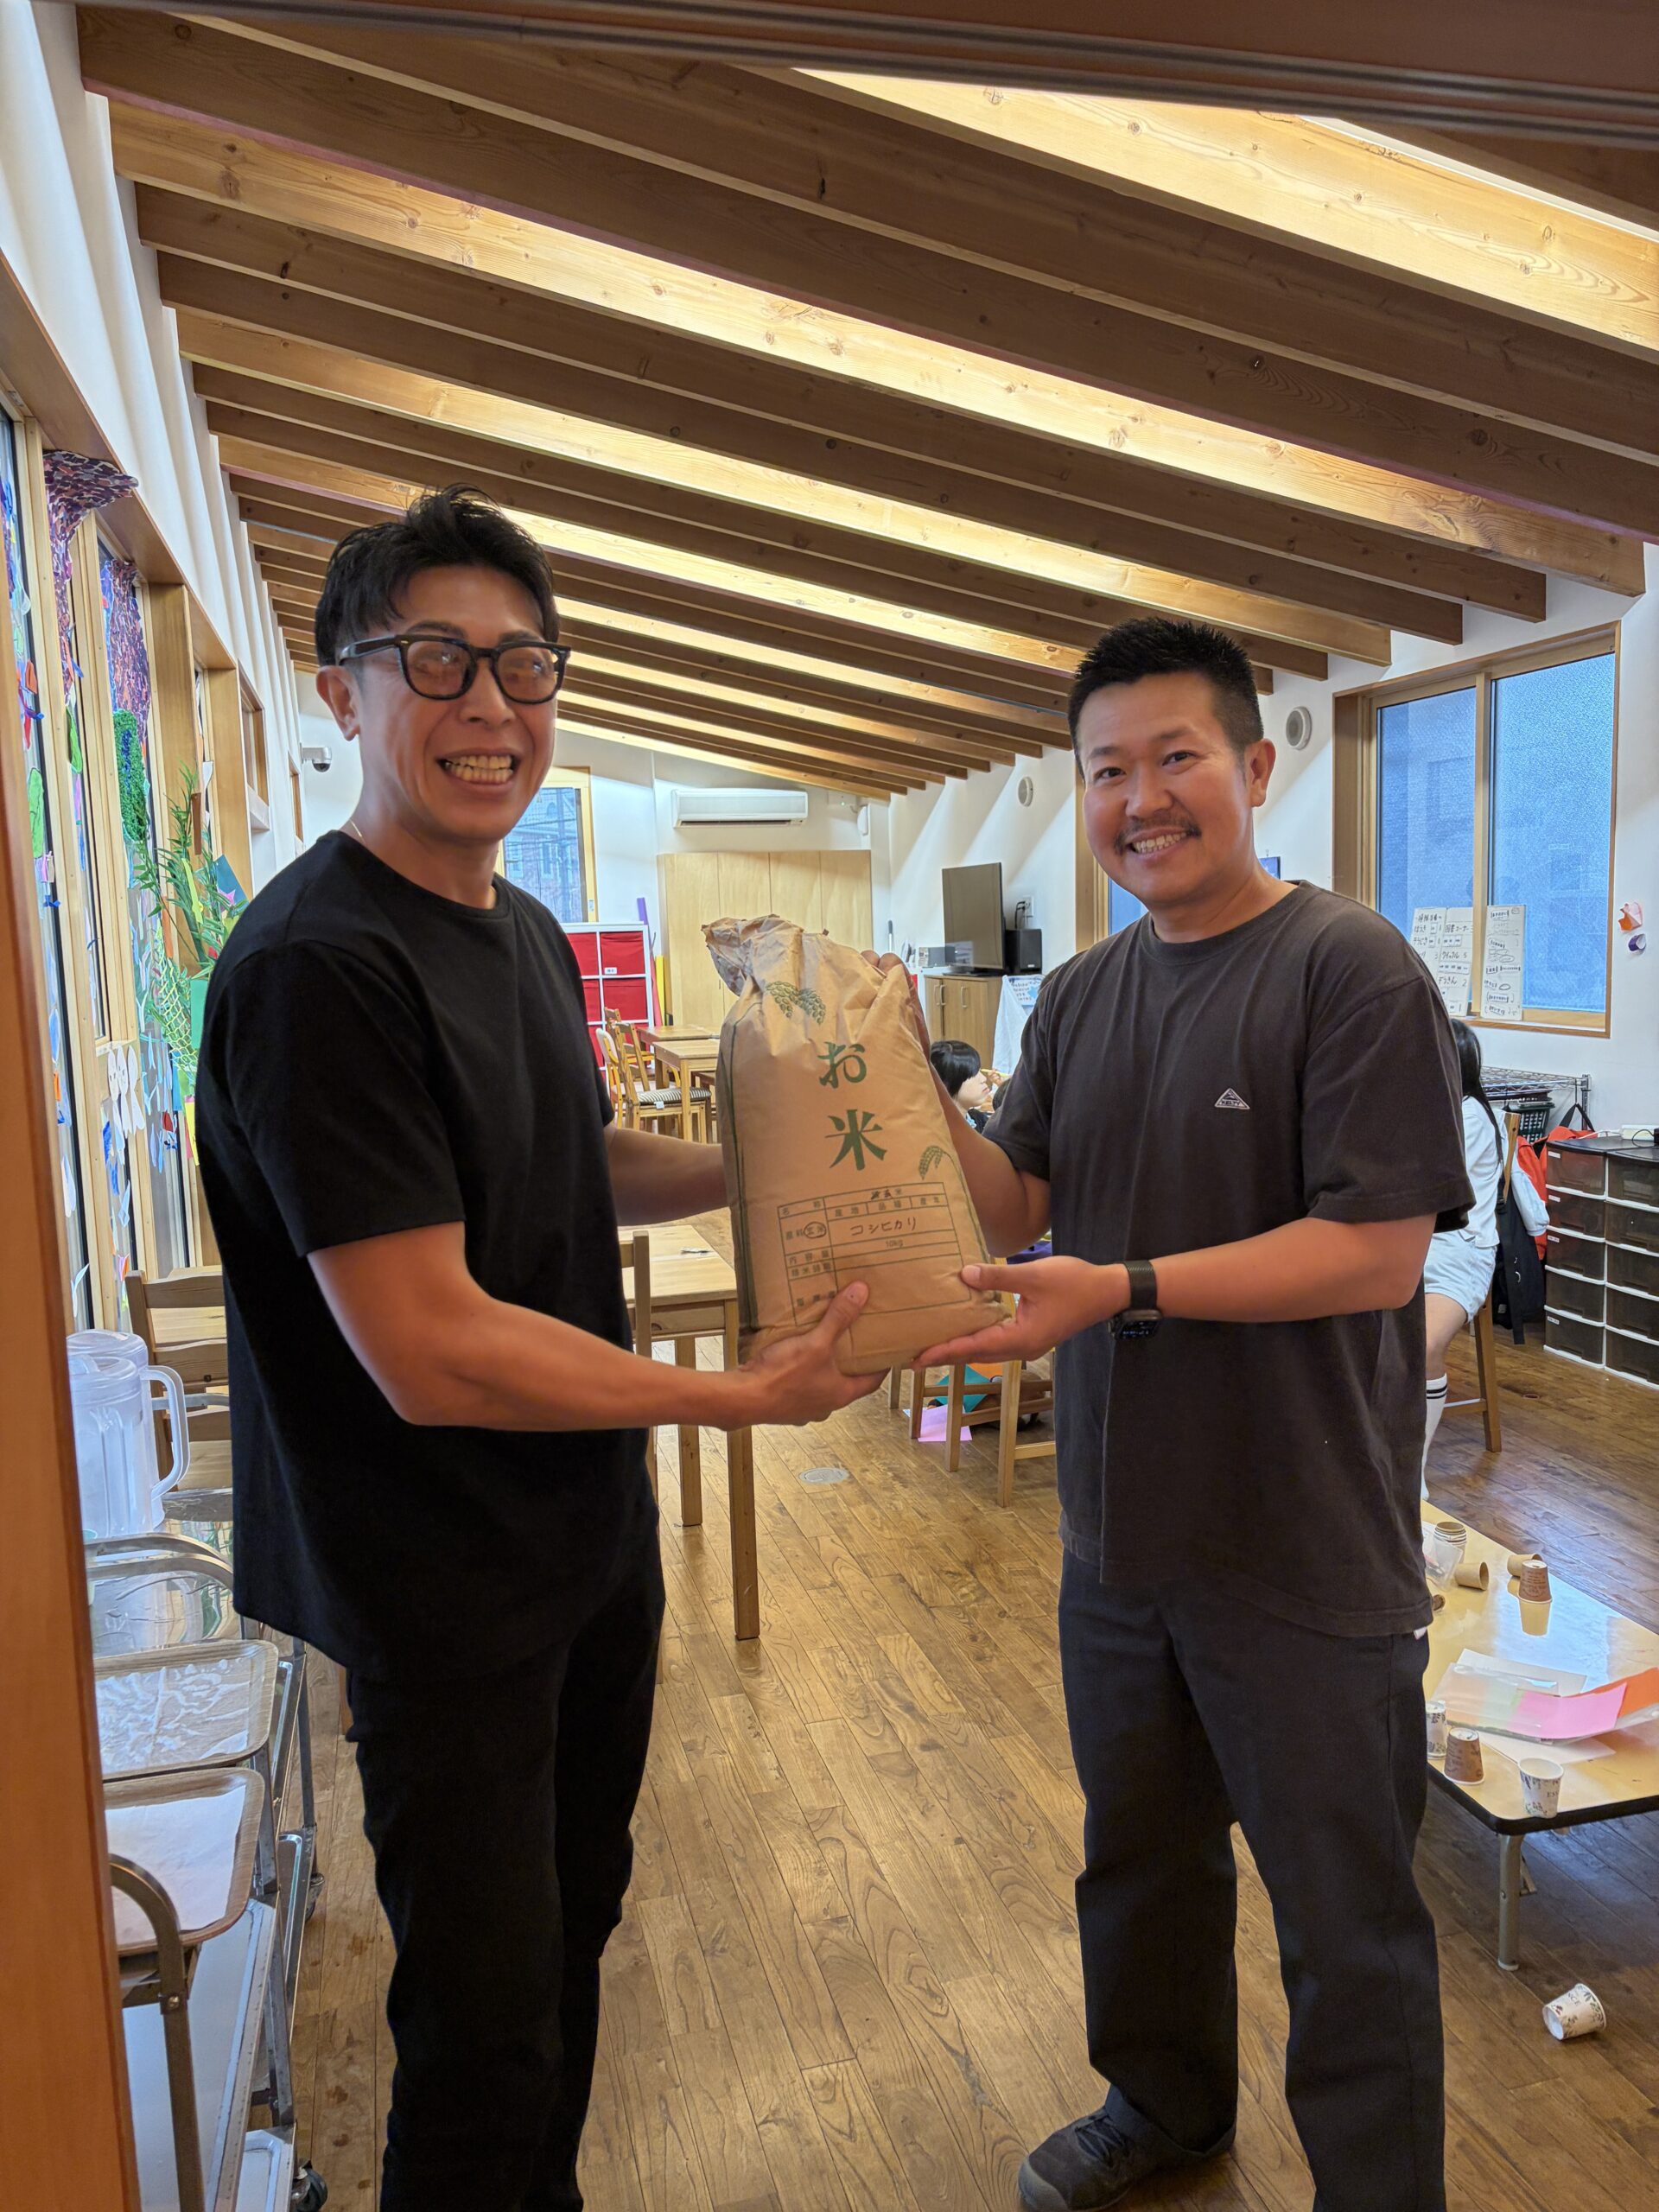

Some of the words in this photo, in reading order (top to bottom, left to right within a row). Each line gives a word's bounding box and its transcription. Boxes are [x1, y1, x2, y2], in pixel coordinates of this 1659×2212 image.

[850, 1216, 916, 1236] コシヒカリ
